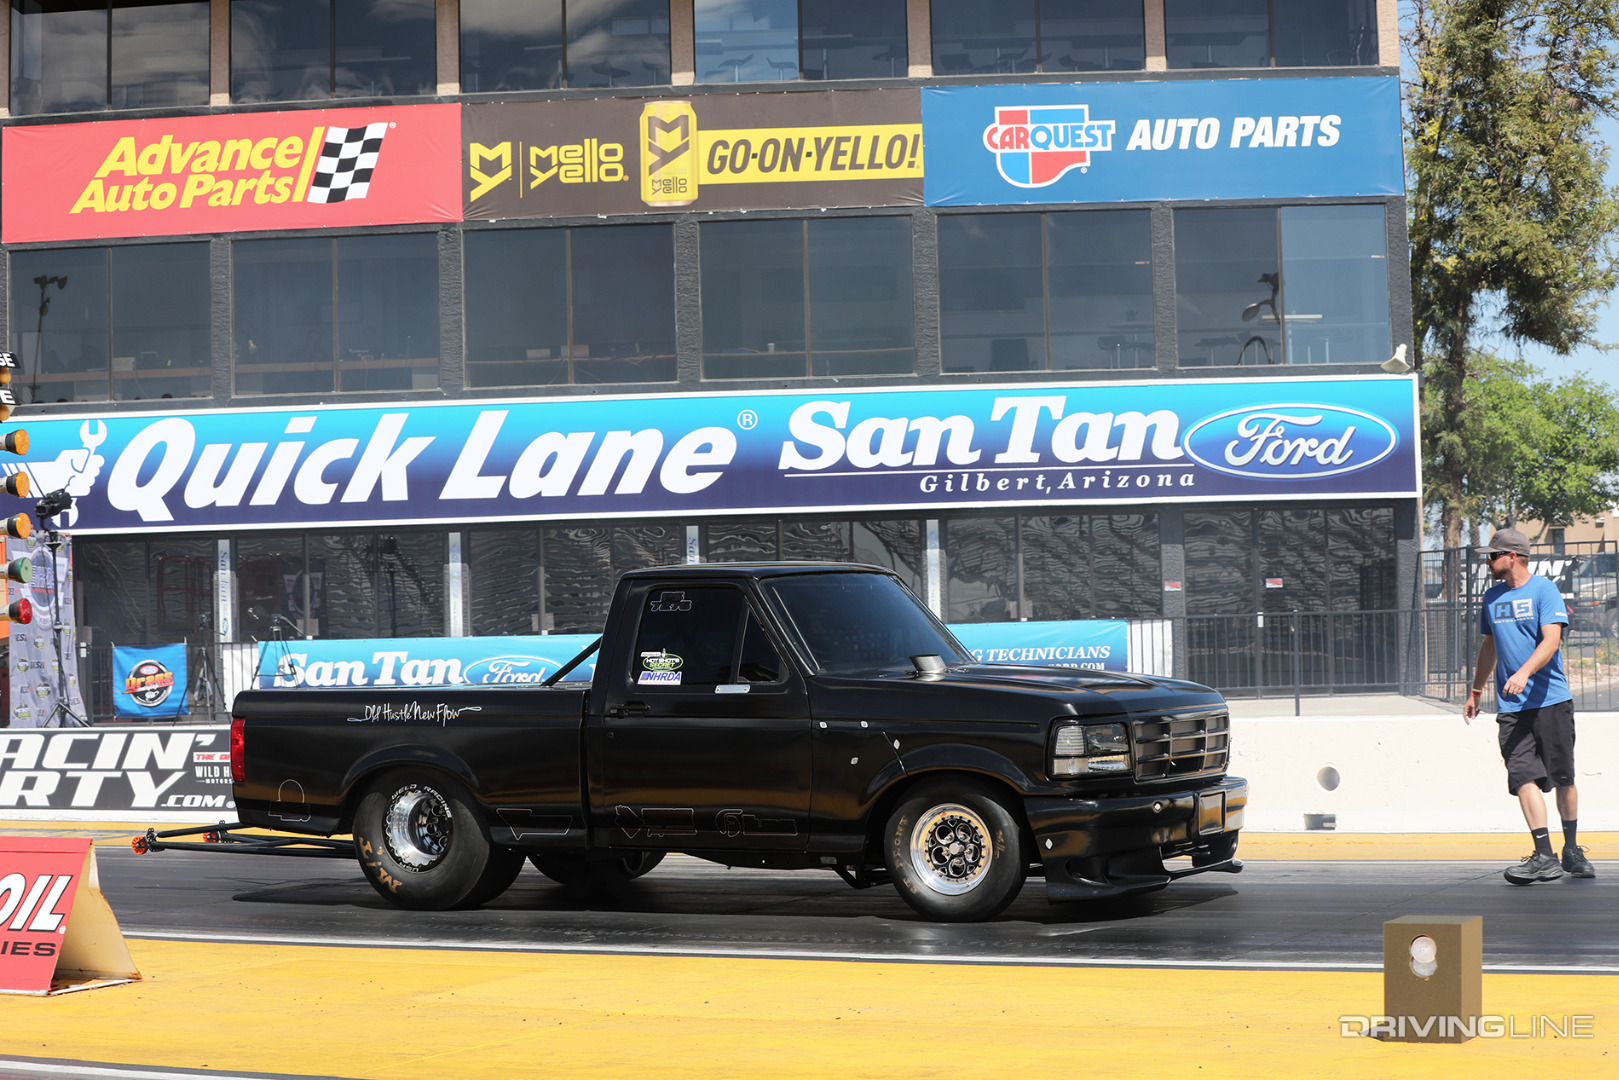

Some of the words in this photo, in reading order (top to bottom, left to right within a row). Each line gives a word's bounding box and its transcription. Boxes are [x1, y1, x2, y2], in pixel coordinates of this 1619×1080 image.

[986, 123, 1112, 151] CARQUEST
[1126, 117, 1221, 151] AUTO
[1229, 114, 1342, 149] PARTS
[94, 134, 303, 178] Advance
[69, 179, 177, 214] Auto
[179, 172, 293, 209] Parts
[778, 400, 982, 471] San
[990, 395, 1185, 464] Tan
[1224, 412, 1357, 467] Ford
[107, 412, 437, 522] Quick
[438, 409, 738, 500] Lane
[919, 475, 1052, 495] Gilbert,
[1057, 470, 1196, 491] Arizona
[273, 653, 368, 687] San
[373, 651, 464, 685] Tan
[986, 645, 1111, 662] TECHNICIANS
[125, 671, 174, 691] Drags
[645, 672, 682, 682] NHRDA
[364, 704, 382, 723] Old
[382, 702, 412, 723] Hustle
[410, 700, 435, 721] New
[436, 702, 461, 728] Flow
[194, 765, 220, 778] WILD
[196, 753, 215, 761] THE
[391, 783, 418, 801] WELD
[423, 785, 453, 819] RACING
